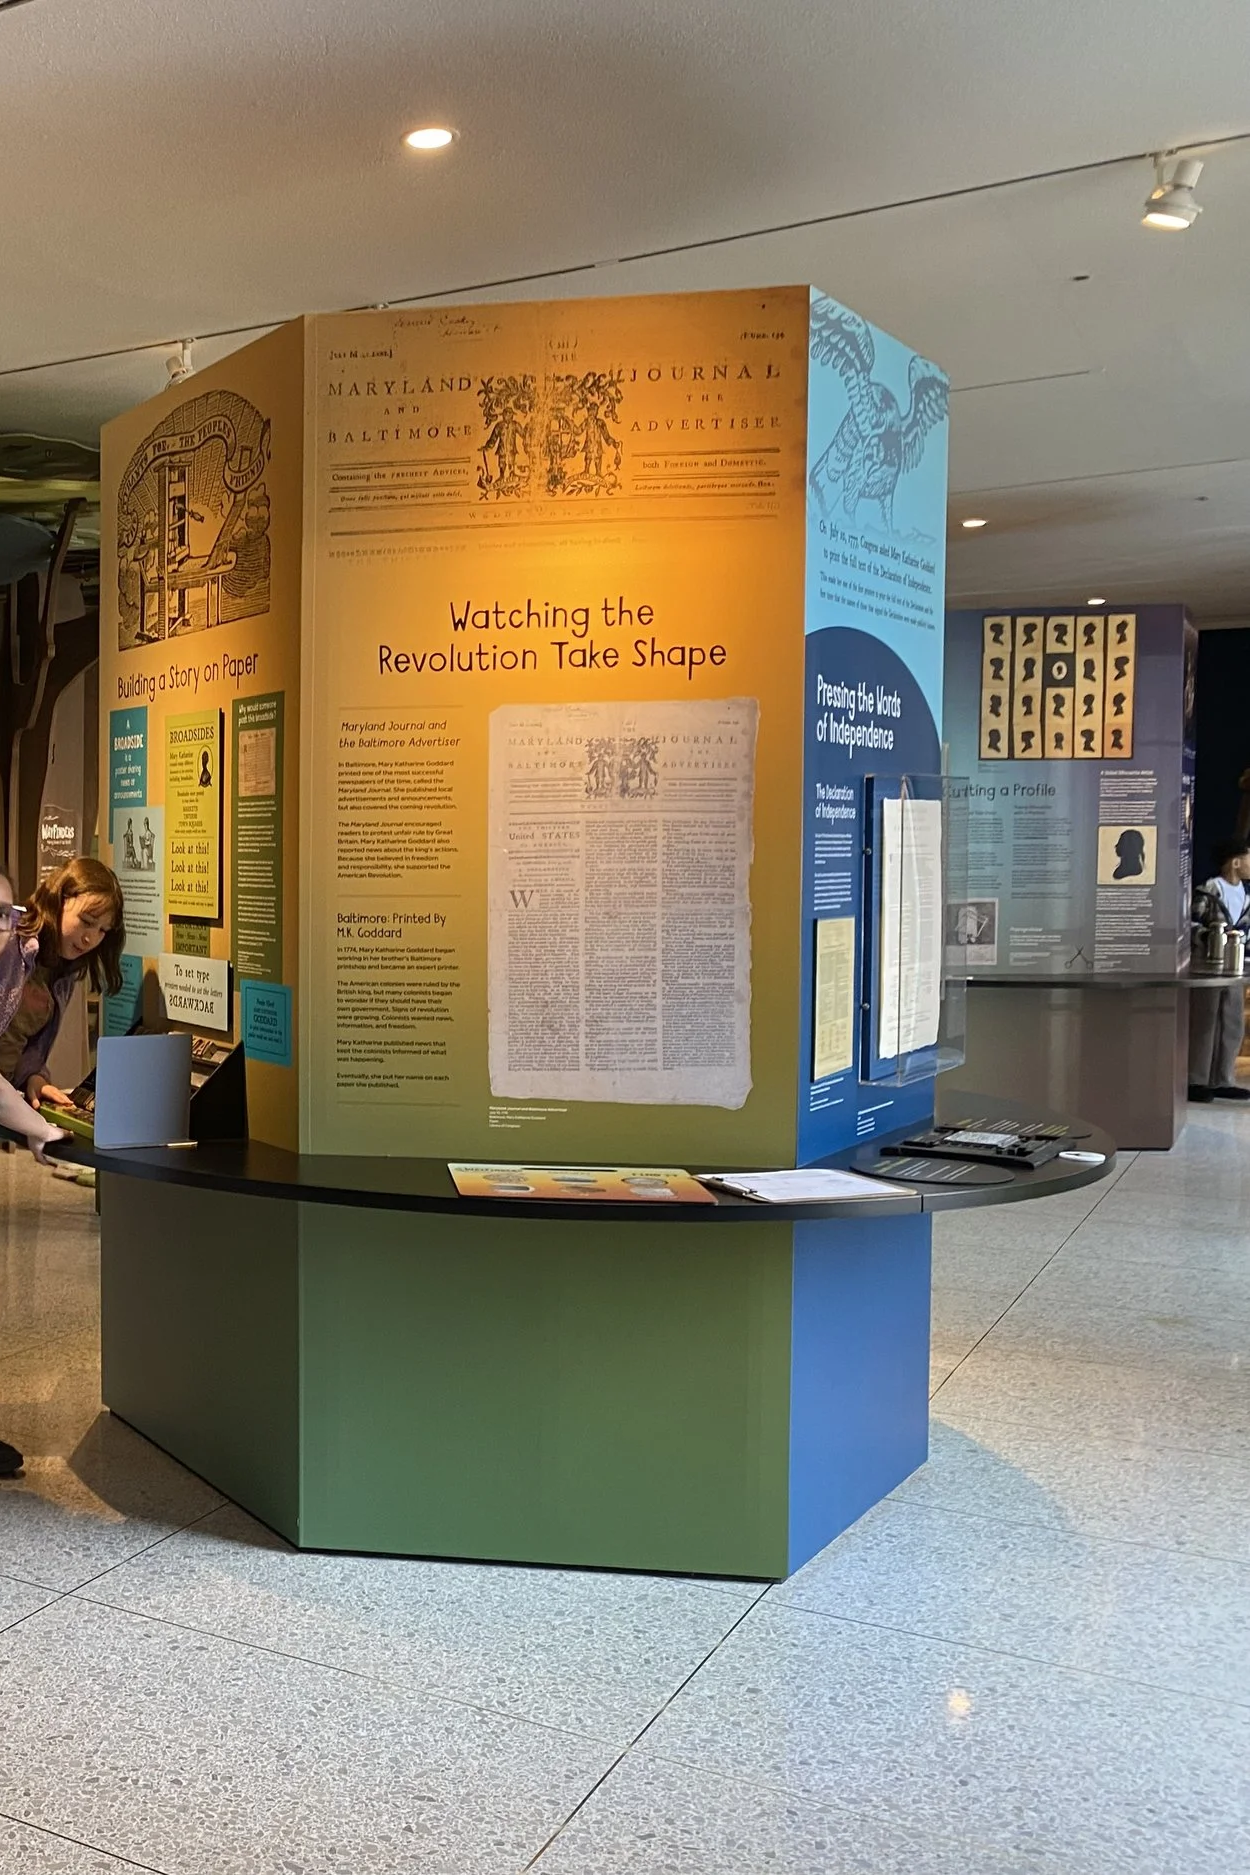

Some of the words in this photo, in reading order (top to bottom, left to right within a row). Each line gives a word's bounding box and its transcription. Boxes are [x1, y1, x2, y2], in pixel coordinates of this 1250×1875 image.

[328, 376, 472, 396] MARYLAND
[630, 364, 780, 382] JOURNAL
[384, 406, 420, 415] AND
[687, 394, 724, 402] THE
[179, 435, 195, 448] THE
[198, 420, 231, 442] PEOPLES
[328, 425, 472, 444] BALTIMORE
[630, 416, 781, 432] ADVERTISER
[332, 472, 370, 482] Containing
[374, 471, 386, 479] the
[643, 460, 659, 469] both
[704, 458, 717, 467] and
[450, 599, 590, 638] Watching
[601, 596, 654, 626] the
[379, 643, 537, 675] Revolution
[550, 640, 619, 670] Take
[632, 637, 727, 680] Shape
[118, 673, 155, 702] Building
[159, 675, 166, 690] a
[169, 664, 200, 694] Story
[204, 662, 218, 682] on
[223, 653, 258, 690] Paper
[817, 674, 856, 721] Pressing
[857, 681, 874, 713] the
[876, 685, 901, 718] Words
[170, 726, 214, 744] BROADSIDES
[341, 721, 386, 734] Maryland
[388, 720, 425, 731] Journal
[428, 720, 447, 730] and
[114, 734, 143, 751] BROADSIDE
[339, 738, 355, 748] the
[358, 737, 405, 748] Baltimore
[409, 737, 461, 747] Advertiser
[508, 737, 582, 746] MARYLAND
[662, 736, 737, 744] JOURNAL
[816, 712, 829, 742] of
[830, 712, 894, 760] Independence
[508, 761, 583, 769] BALTIMORE
[816, 783, 825, 800] The
[826, 784, 854, 800] Declaration
[1000, 786, 1009, 796] a
[1014, 783, 1056, 797] Profile
[815, 803, 821, 818] of
[821, 803, 856, 826] Independence
[509, 831, 534, 840] United
[542, 830, 580, 840] STATES
[172, 842, 185, 854] Look
[188, 844, 194, 854] at
[196, 842, 209, 855] this!
[171, 860, 185, 873] Look
[188, 863, 193, 873] at
[196, 860, 209, 874] this!
[171, 878, 185, 892] Look
[188, 882, 193, 892] at
[196, 880, 209, 893] this!
[337, 913, 390, 924] Baltimore:
[393, 913, 430, 924] Printed
[434, 913, 446, 927] By
[337, 927, 354, 938] M.K.
[358, 927, 402, 938] Goddard
[176, 942, 207, 955] IMPORTANT
[174, 964, 182, 976] To
[185, 969, 194, 978] set
[197, 970, 210, 983] type
